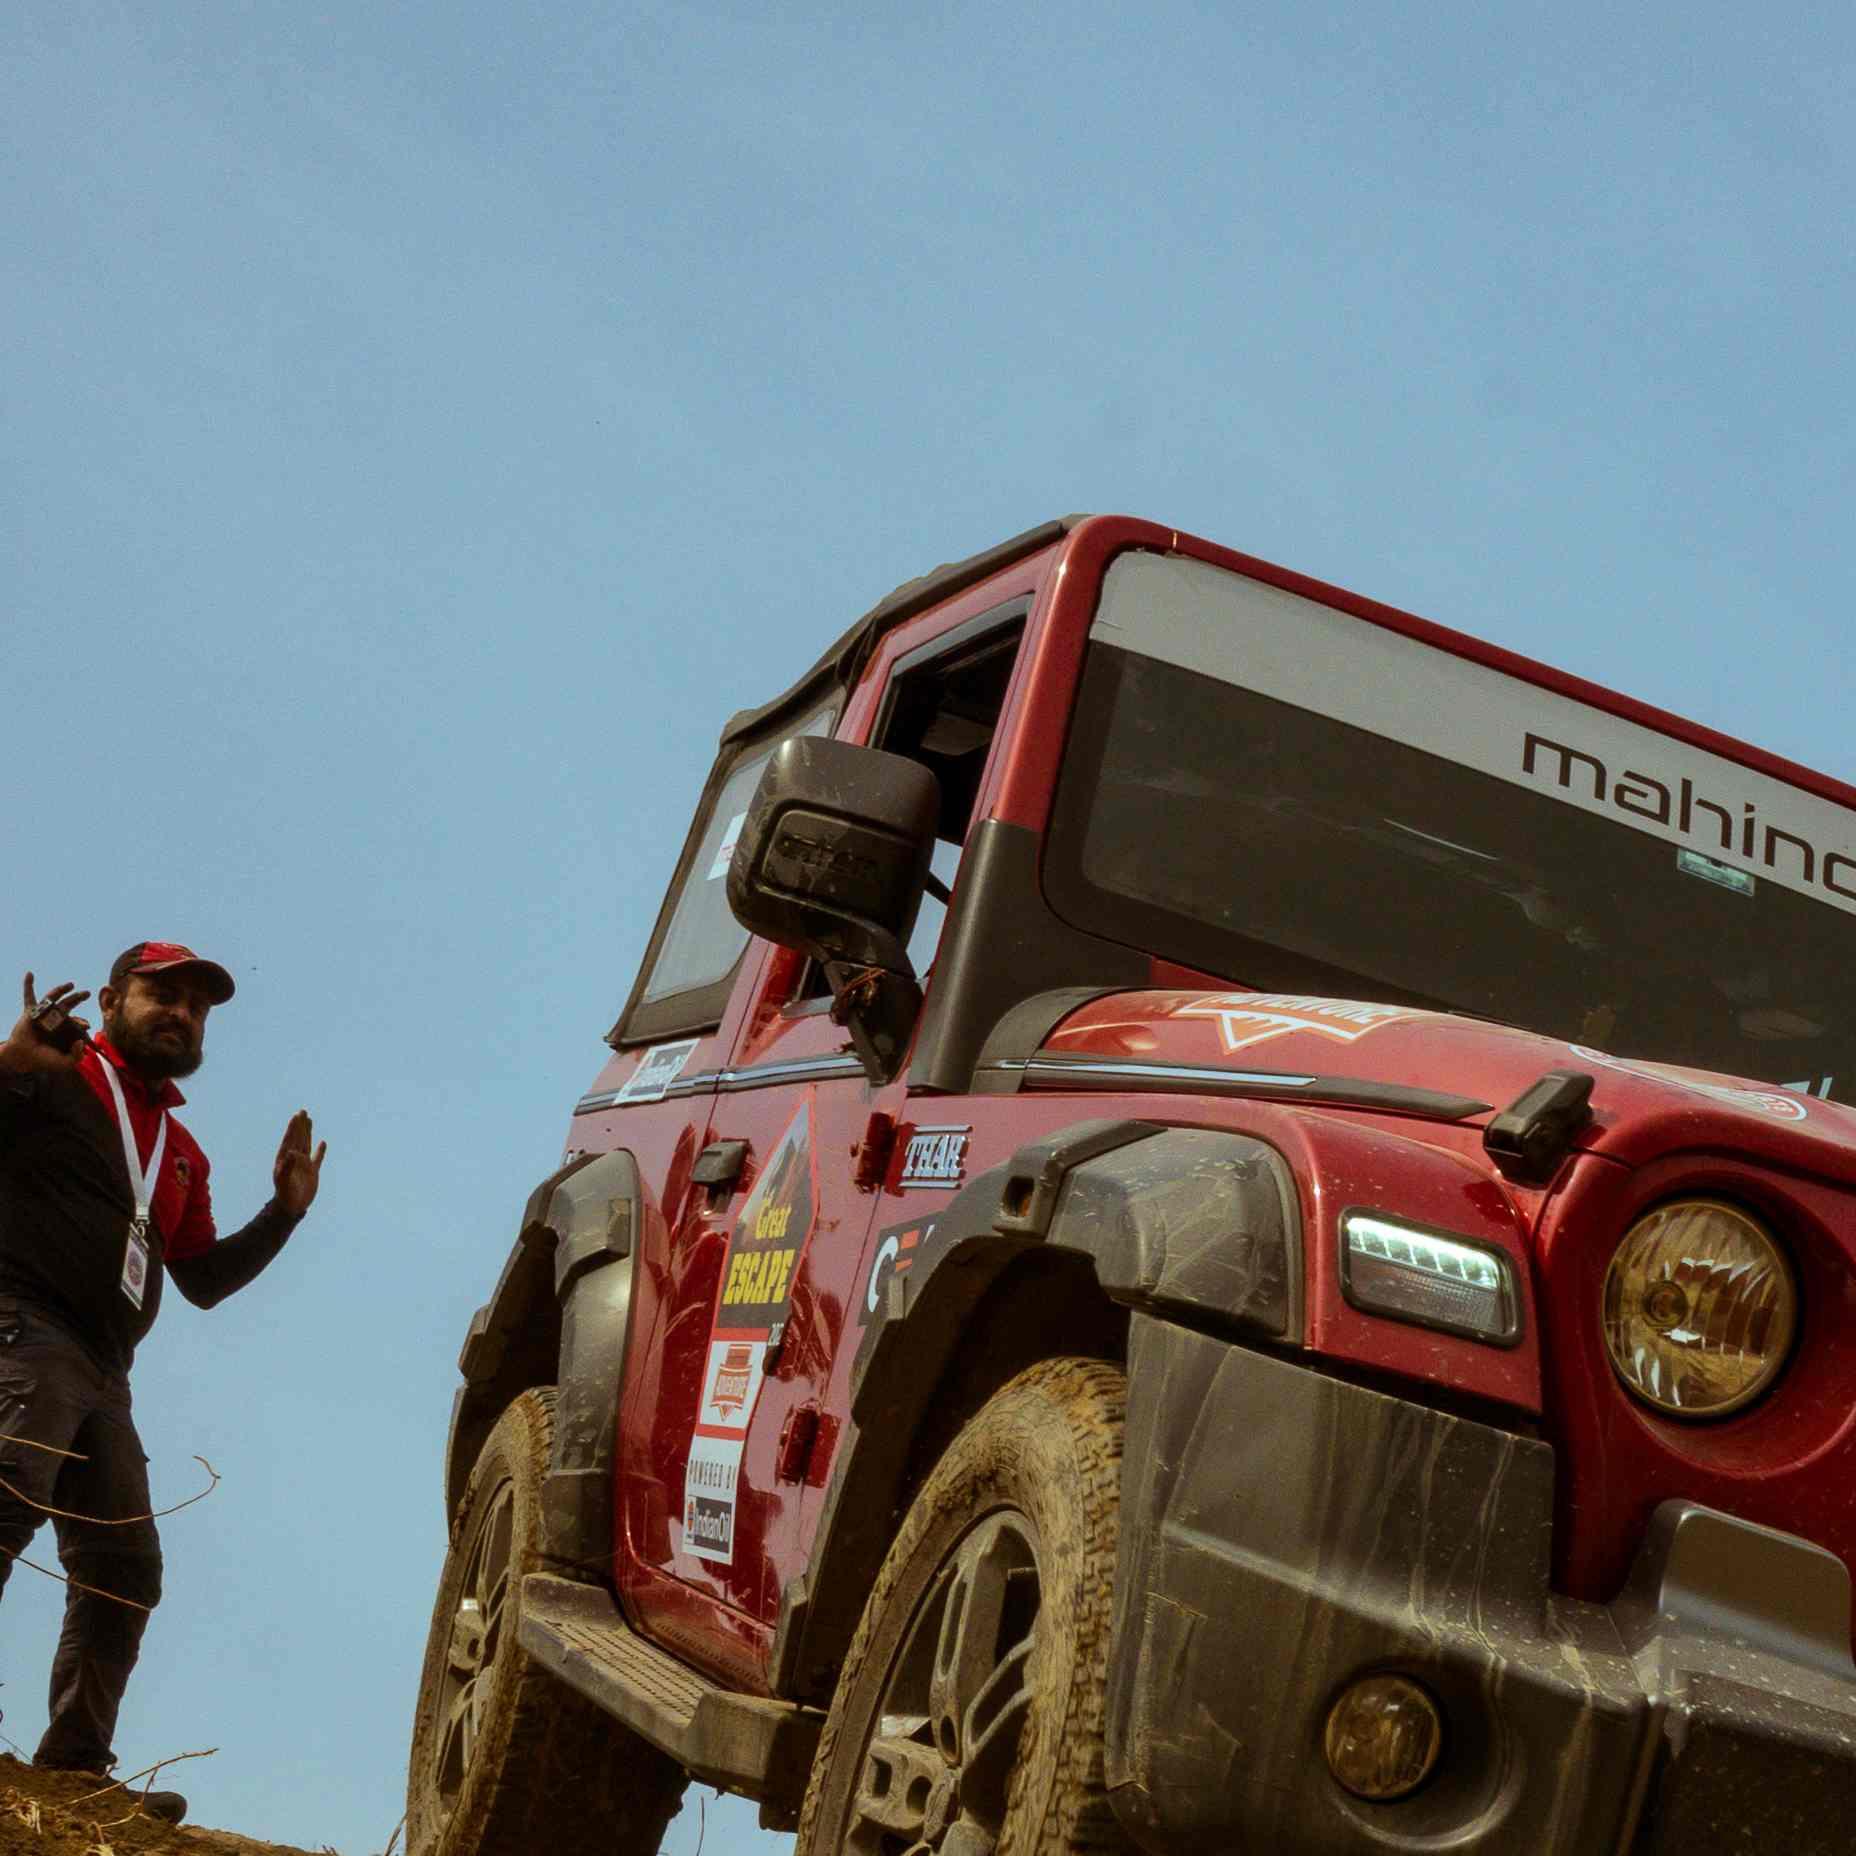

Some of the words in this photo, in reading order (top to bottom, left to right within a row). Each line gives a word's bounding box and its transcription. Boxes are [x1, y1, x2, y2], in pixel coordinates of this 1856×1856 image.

[902, 1135, 966, 1177] THAR
[755, 1203, 791, 1240] Great
[723, 1249, 796, 1305] ESCAPE
[688, 1459, 724, 1488] POWERED
[694, 1507, 730, 1542] IndianOil
